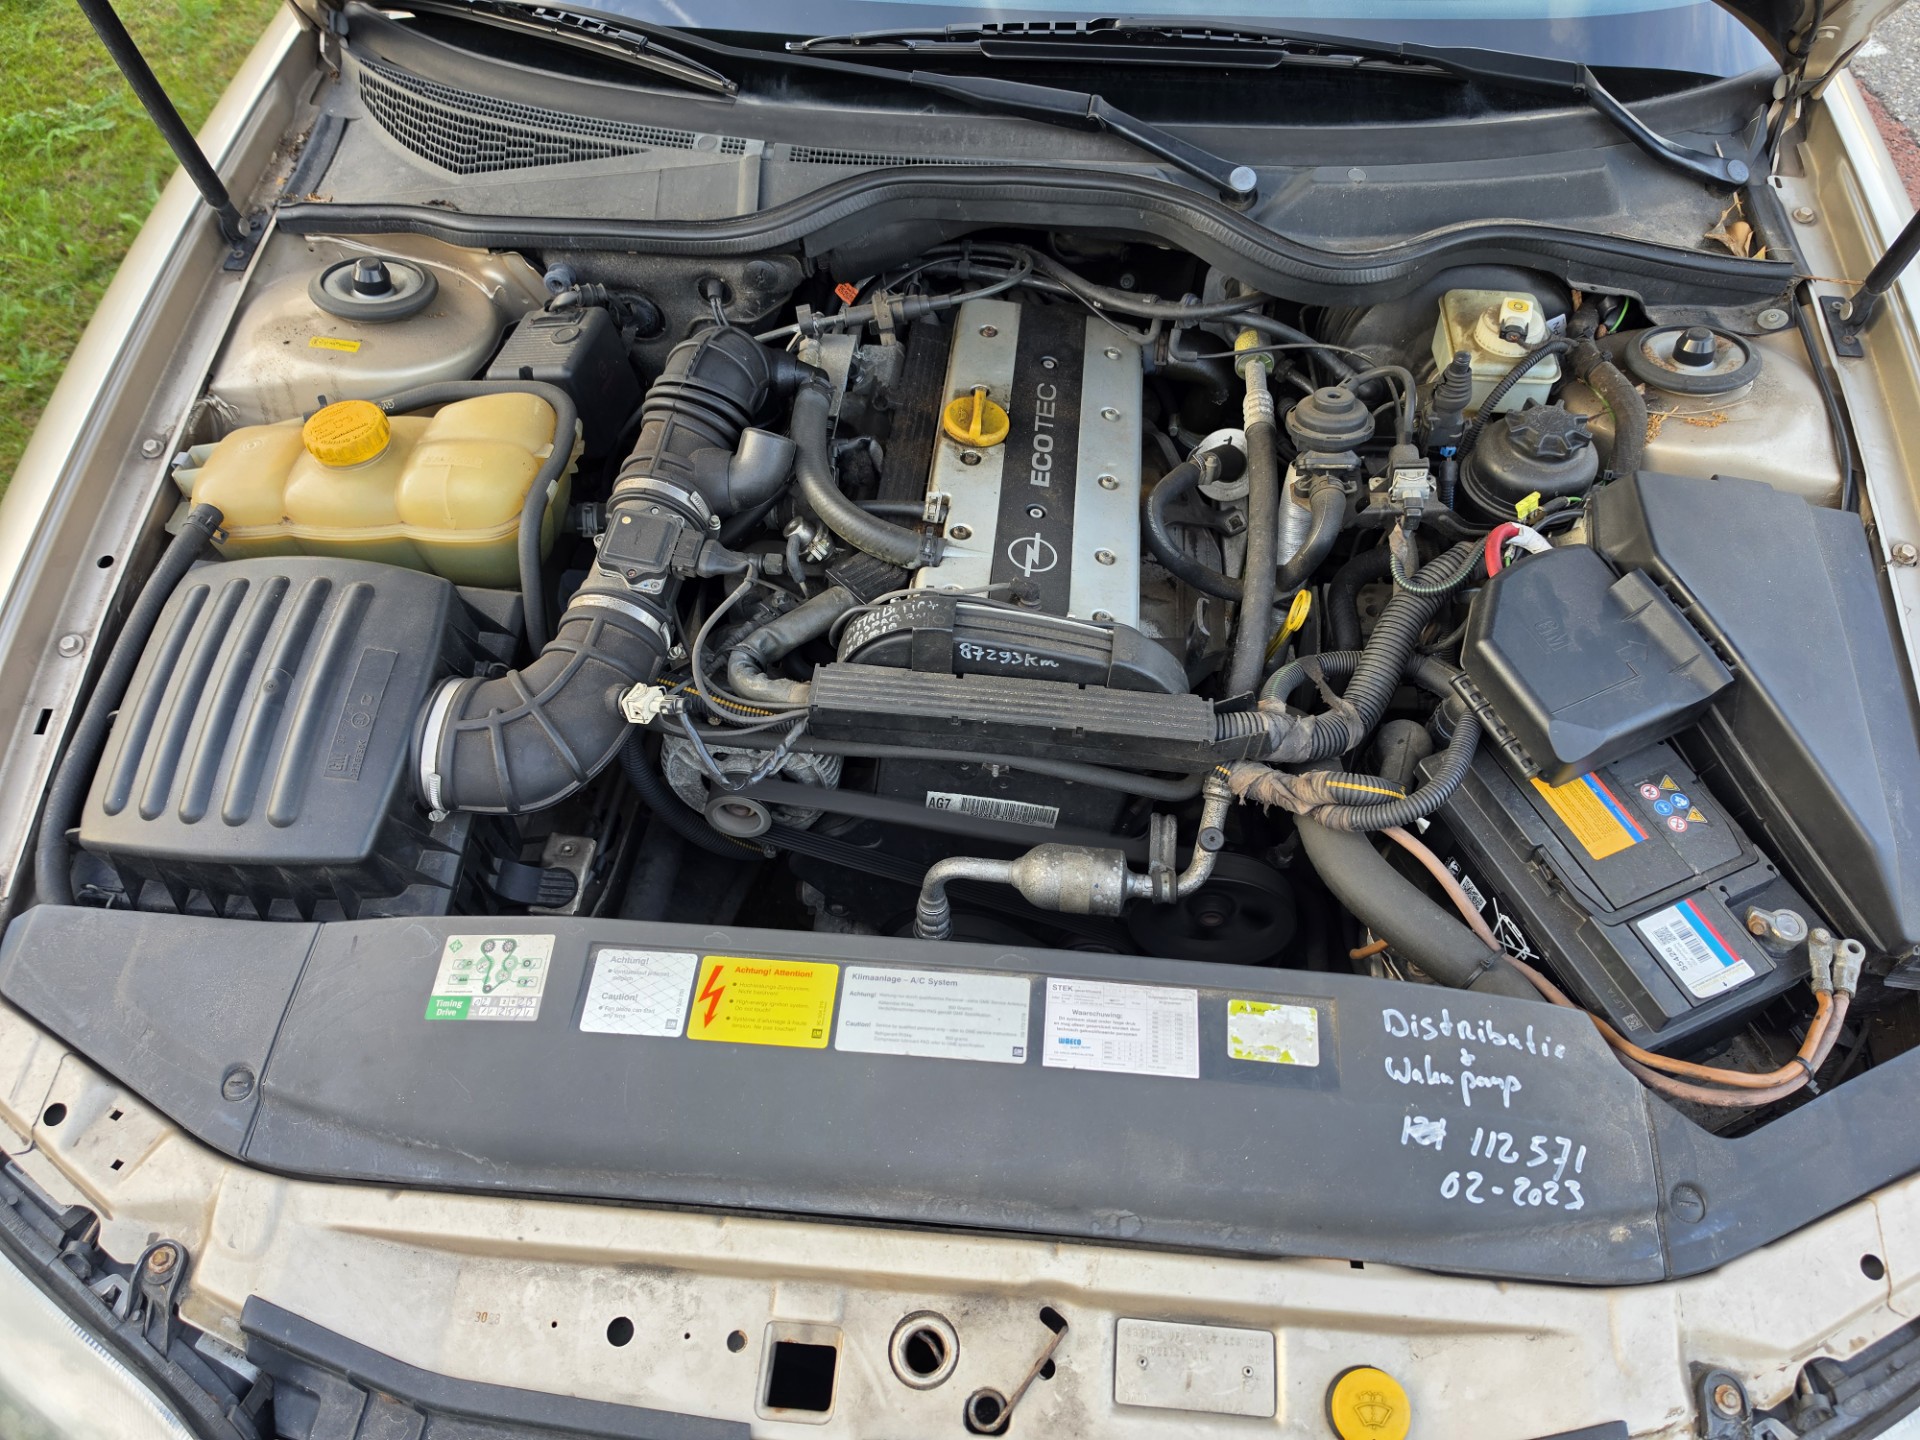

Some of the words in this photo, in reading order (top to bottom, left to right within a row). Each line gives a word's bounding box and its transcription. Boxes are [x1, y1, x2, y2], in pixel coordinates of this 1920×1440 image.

[1030, 382, 1057, 488] ECOTEC
[928, 797, 951, 809] AG7
[610, 956, 649, 966] Achtung!
[735, 966, 772, 976] Achtung!
[774, 969, 813, 978] Attention!
[852, 973, 902, 984] Klimaanlage
[910, 976, 925, 984] A/C
[928, 977, 958, 987] System
[1052, 984, 1073, 992] STEK
[601, 992, 638, 1001] Caution!
[435, 1000, 463, 1008] Timing
[436, 1008, 456, 1016] Drive
[1072, 1009, 1123, 1019] Waarschuwing:
